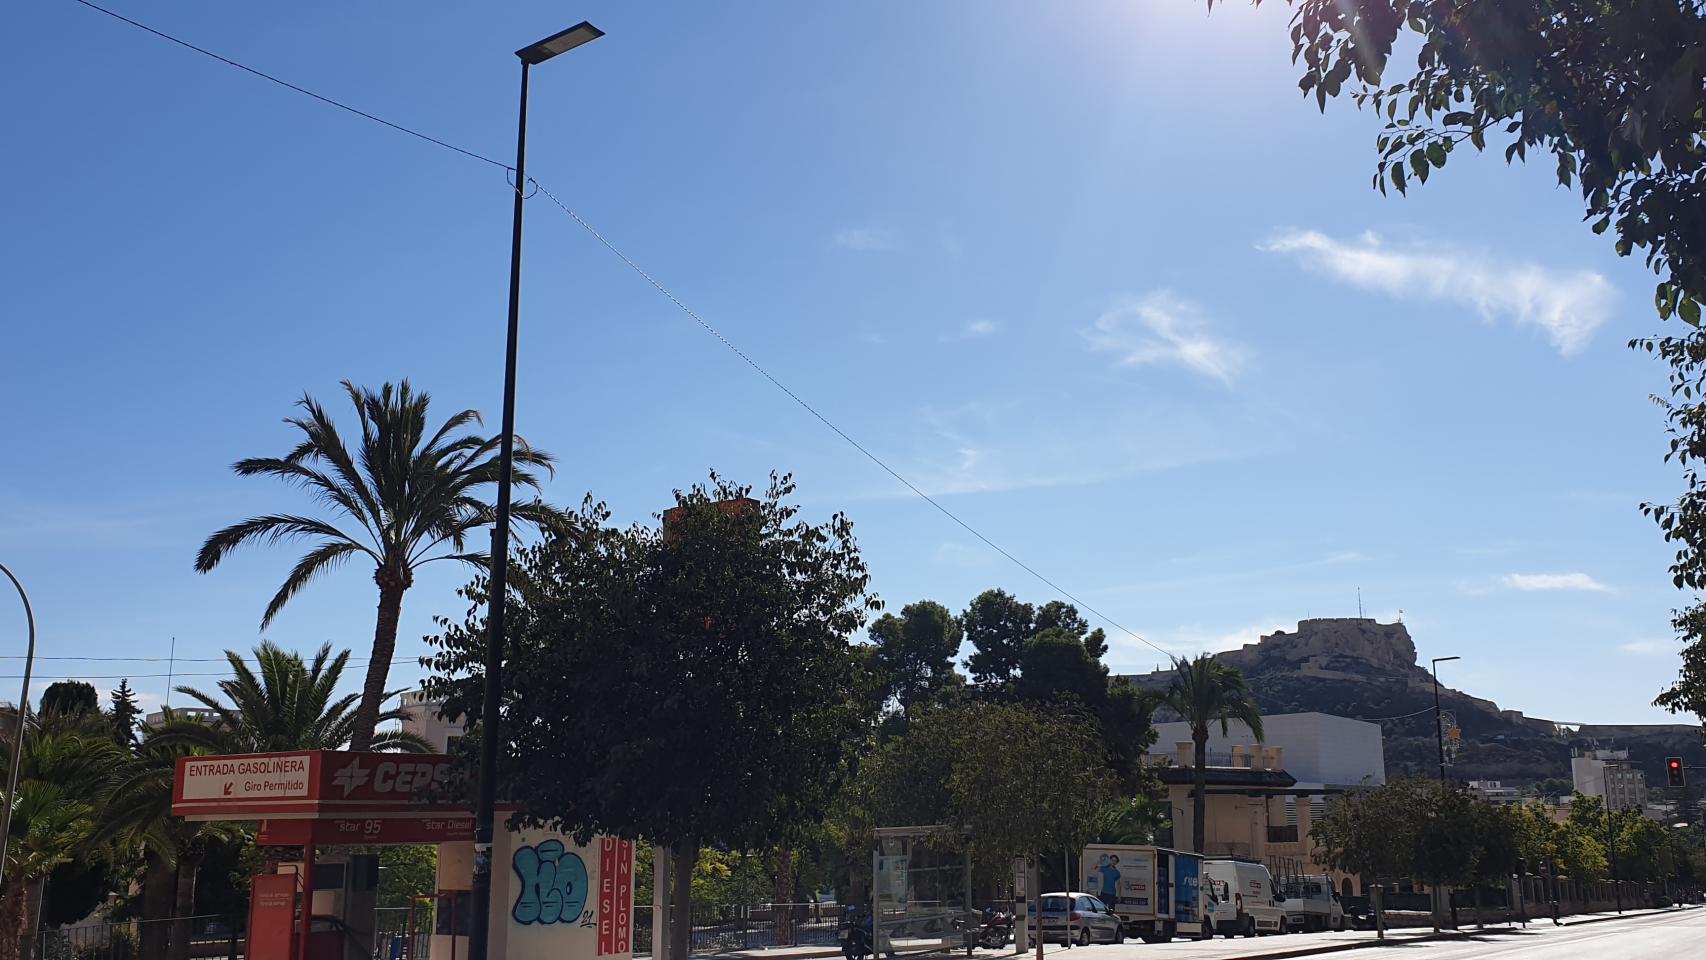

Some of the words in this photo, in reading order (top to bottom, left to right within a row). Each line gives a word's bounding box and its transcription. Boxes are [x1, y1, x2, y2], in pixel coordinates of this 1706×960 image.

[189, 762, 235, 777] ENTRADA
[238, 759, 305, 775] GASOLINERA
[373, 761, 468, 793] CEPS
[244, 781, 262, 792] Giro
[263, 778, 304, 792] Permitido
[339, 820, 360, 832] star
[364, 819, 383, 834] 95
[425, 819, 444, 830] star
[447, 819, 473, 830] Diesel
[620, 840, 629, 876] SIN
[602, 838, 613, 955] DIESEL
[618, 886, 628, 953] PLOMO
